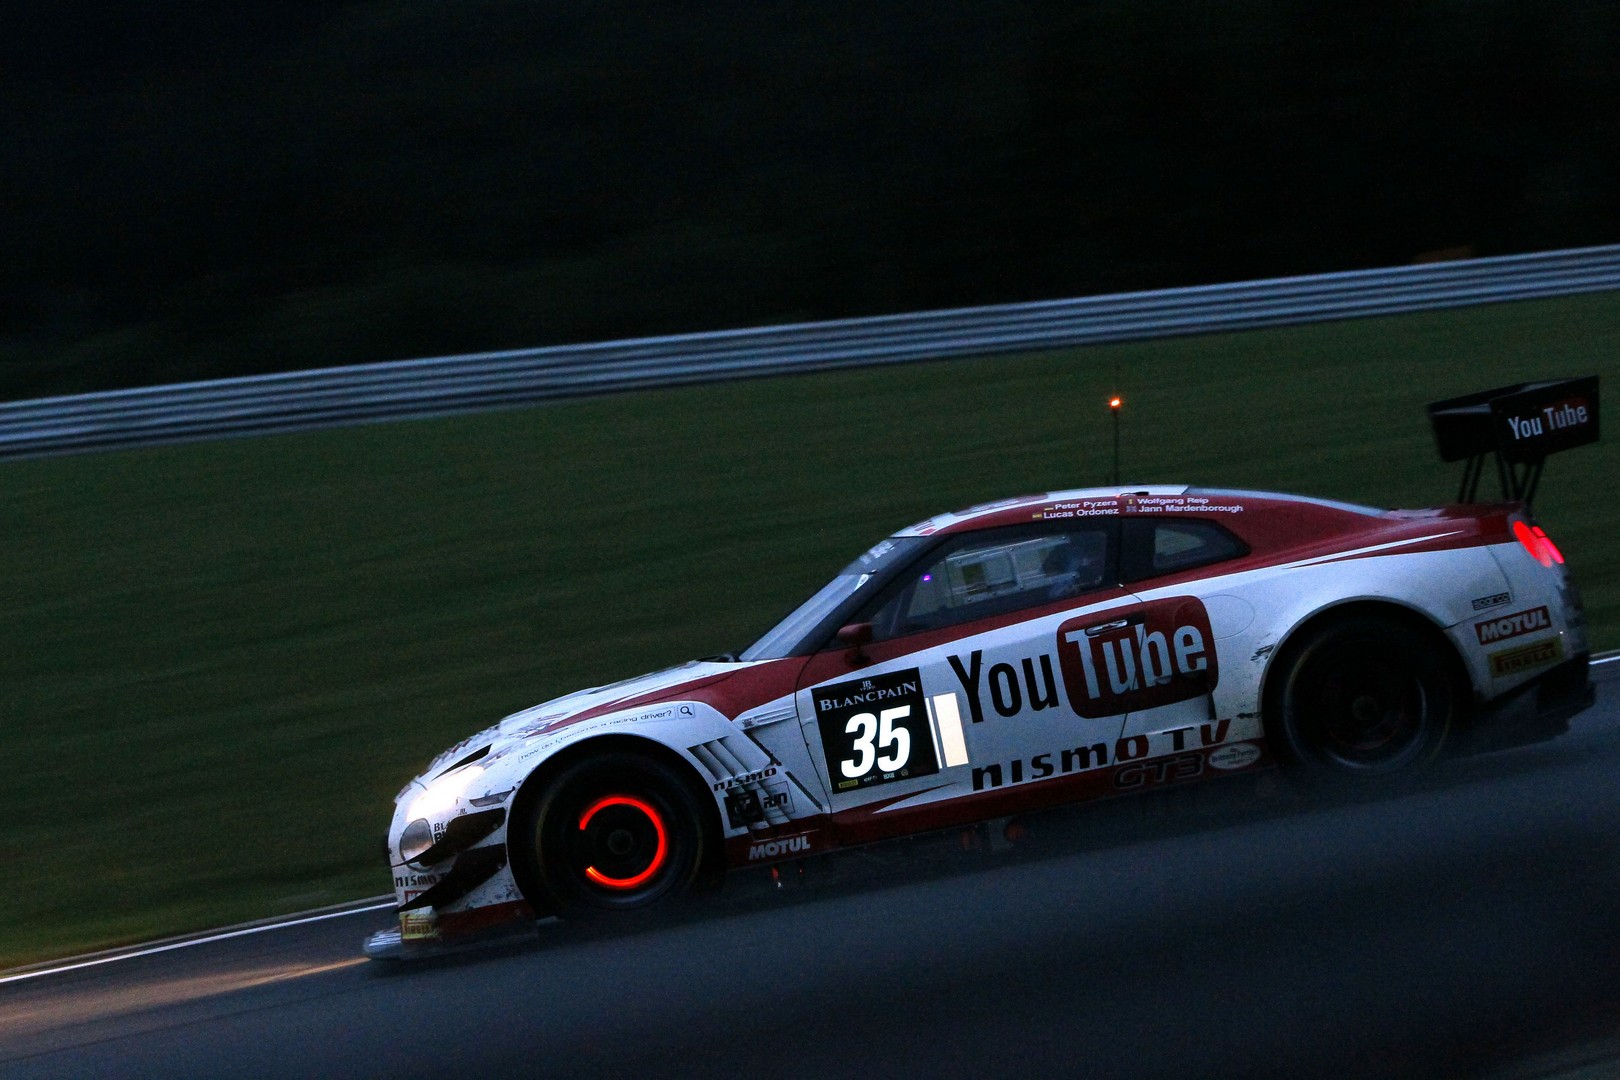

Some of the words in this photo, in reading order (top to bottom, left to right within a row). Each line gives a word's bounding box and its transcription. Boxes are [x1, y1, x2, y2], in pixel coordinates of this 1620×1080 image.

[1507, 414, 1543, 440] You
[1543, 402, 1588, 430] Tube
[1043, 511, 1074, 519] Lucas
[1083, 500, 1118, 509] Pyzera
[1137, 497, 1184, 506] Wolfgang
[1138, 505, 1162, 513] Jann
[1165, 504, 1244, 513] Mardenborough
[1480, 609, 1549, 642] MOTUL
[946, 649, 1060, 724] You
[1065, 623, 1209, 700] Tube
[819, 681, 917, 711] BLANCPAIN
[609, 716, 638, 726] racing
[640, 710, 672, 720] driver?
[840, 704, 911, 778] 35
[1162, 718, 1231, 752] TV
[1112, 750, 1206, 789] GT3
[748, 835, 811, 861] MOTUL
